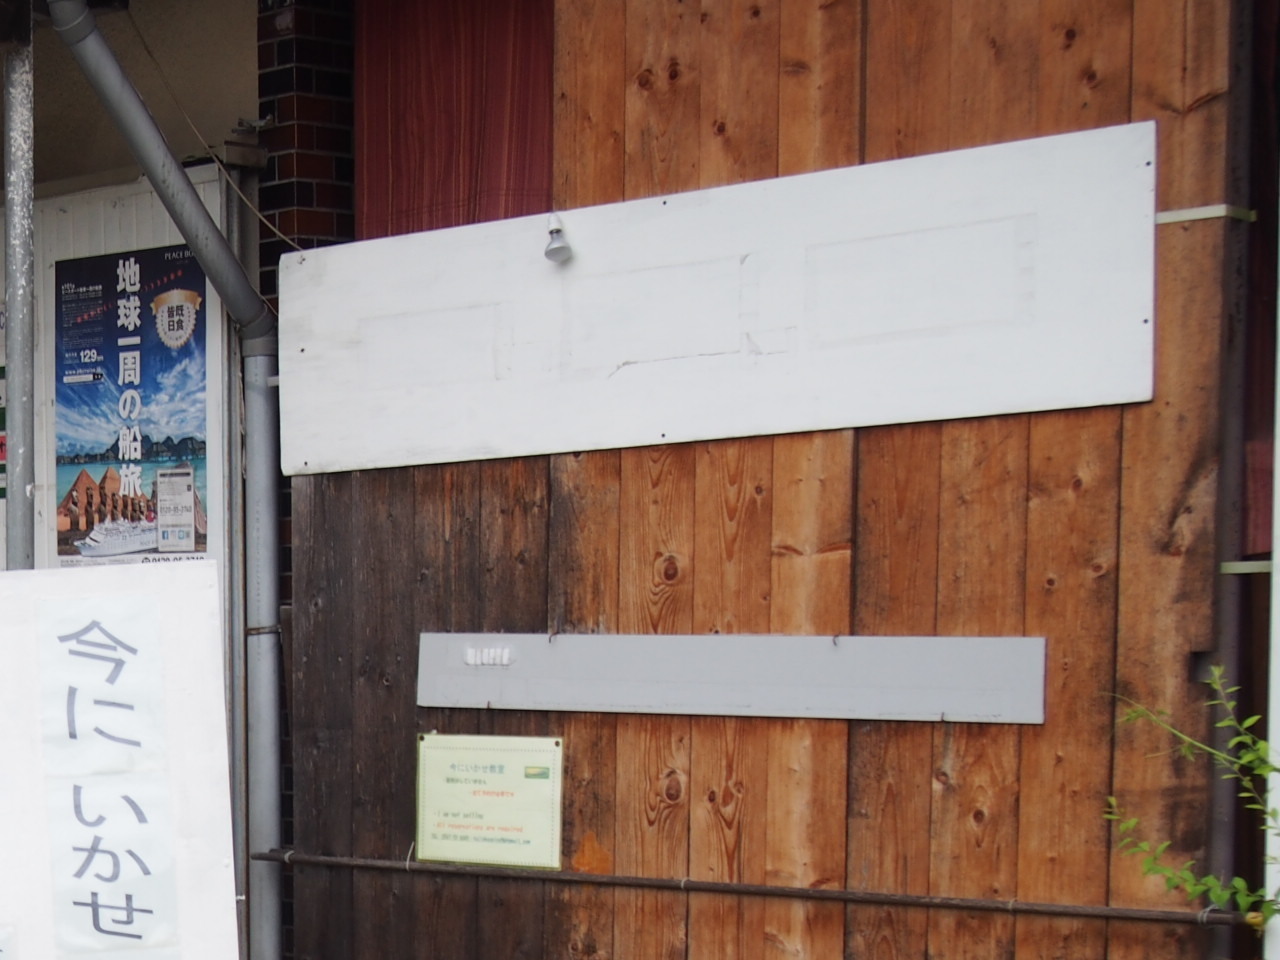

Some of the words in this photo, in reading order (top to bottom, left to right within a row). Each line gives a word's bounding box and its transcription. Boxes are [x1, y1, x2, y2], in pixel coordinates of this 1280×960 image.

[117, 256, 142, 498] 地球一周の船旅
